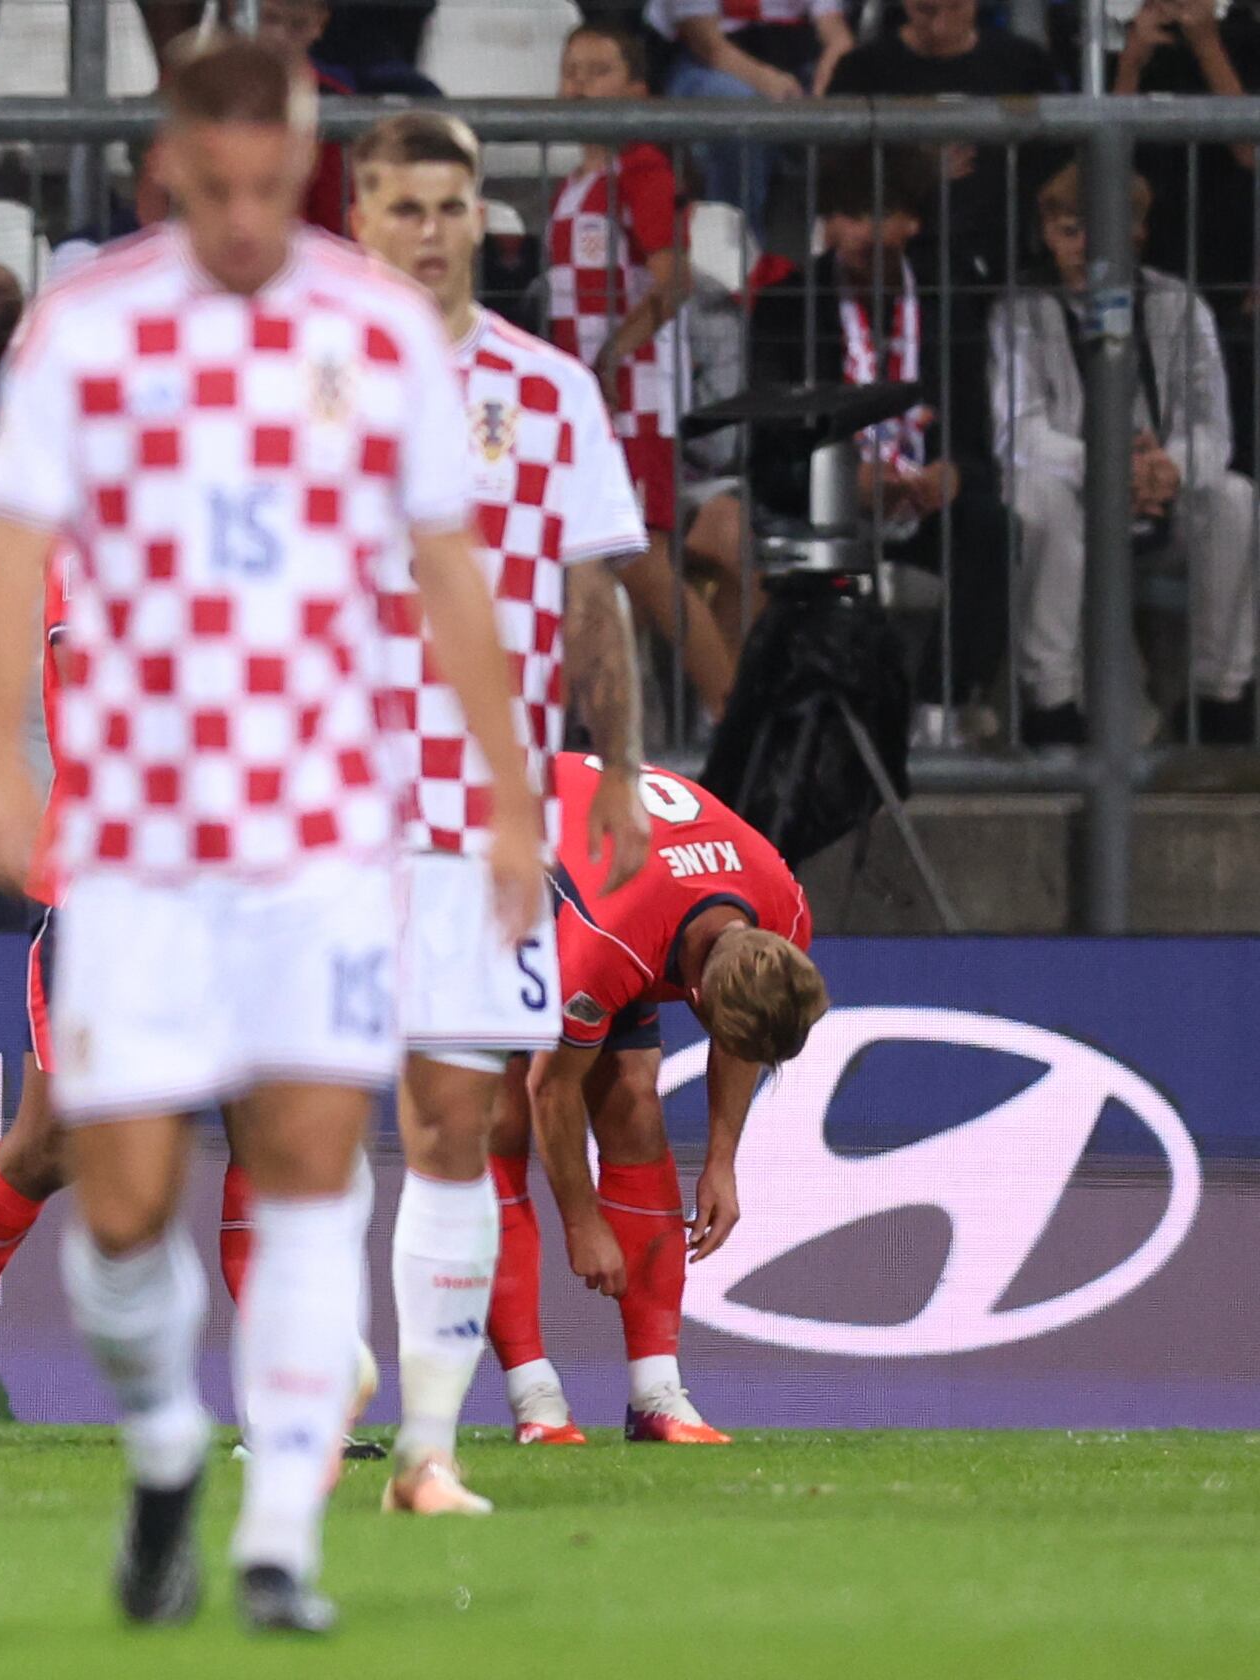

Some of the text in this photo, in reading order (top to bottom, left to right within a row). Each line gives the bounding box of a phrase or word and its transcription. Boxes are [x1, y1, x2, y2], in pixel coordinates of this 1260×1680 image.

[208, 486, 283, 578] 15
[658, 841, 742, 878] KANE
[516, 938, 548, 1012] 5
